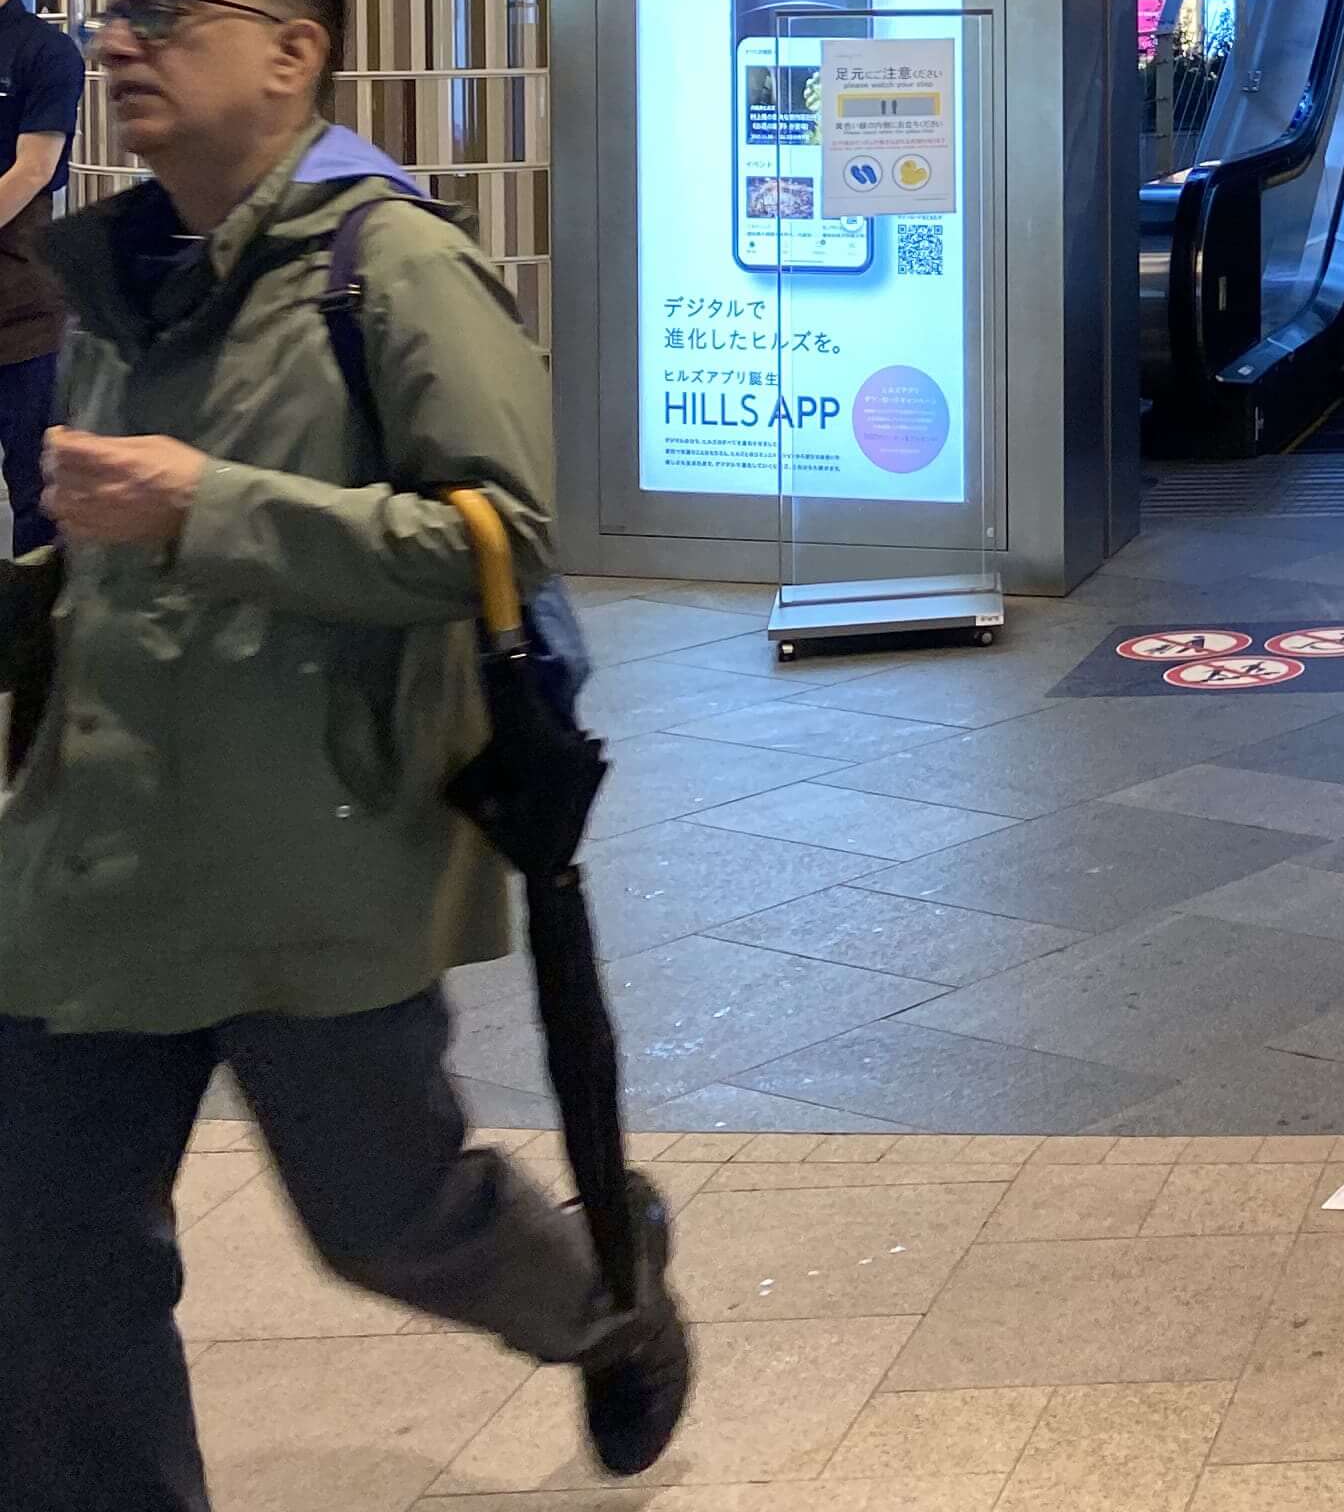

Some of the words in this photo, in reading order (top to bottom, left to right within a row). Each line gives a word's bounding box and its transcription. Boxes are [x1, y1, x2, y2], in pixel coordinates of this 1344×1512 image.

[663, 296, 766, 320] デジタルで
[663, 327, 842, 356] 進化したヒルズを。
[663, 368, 779, 387] ヒルズアプリ誕生
[664, 390, 759, 428] HILLS
[767, 394, 841, 430] APP
